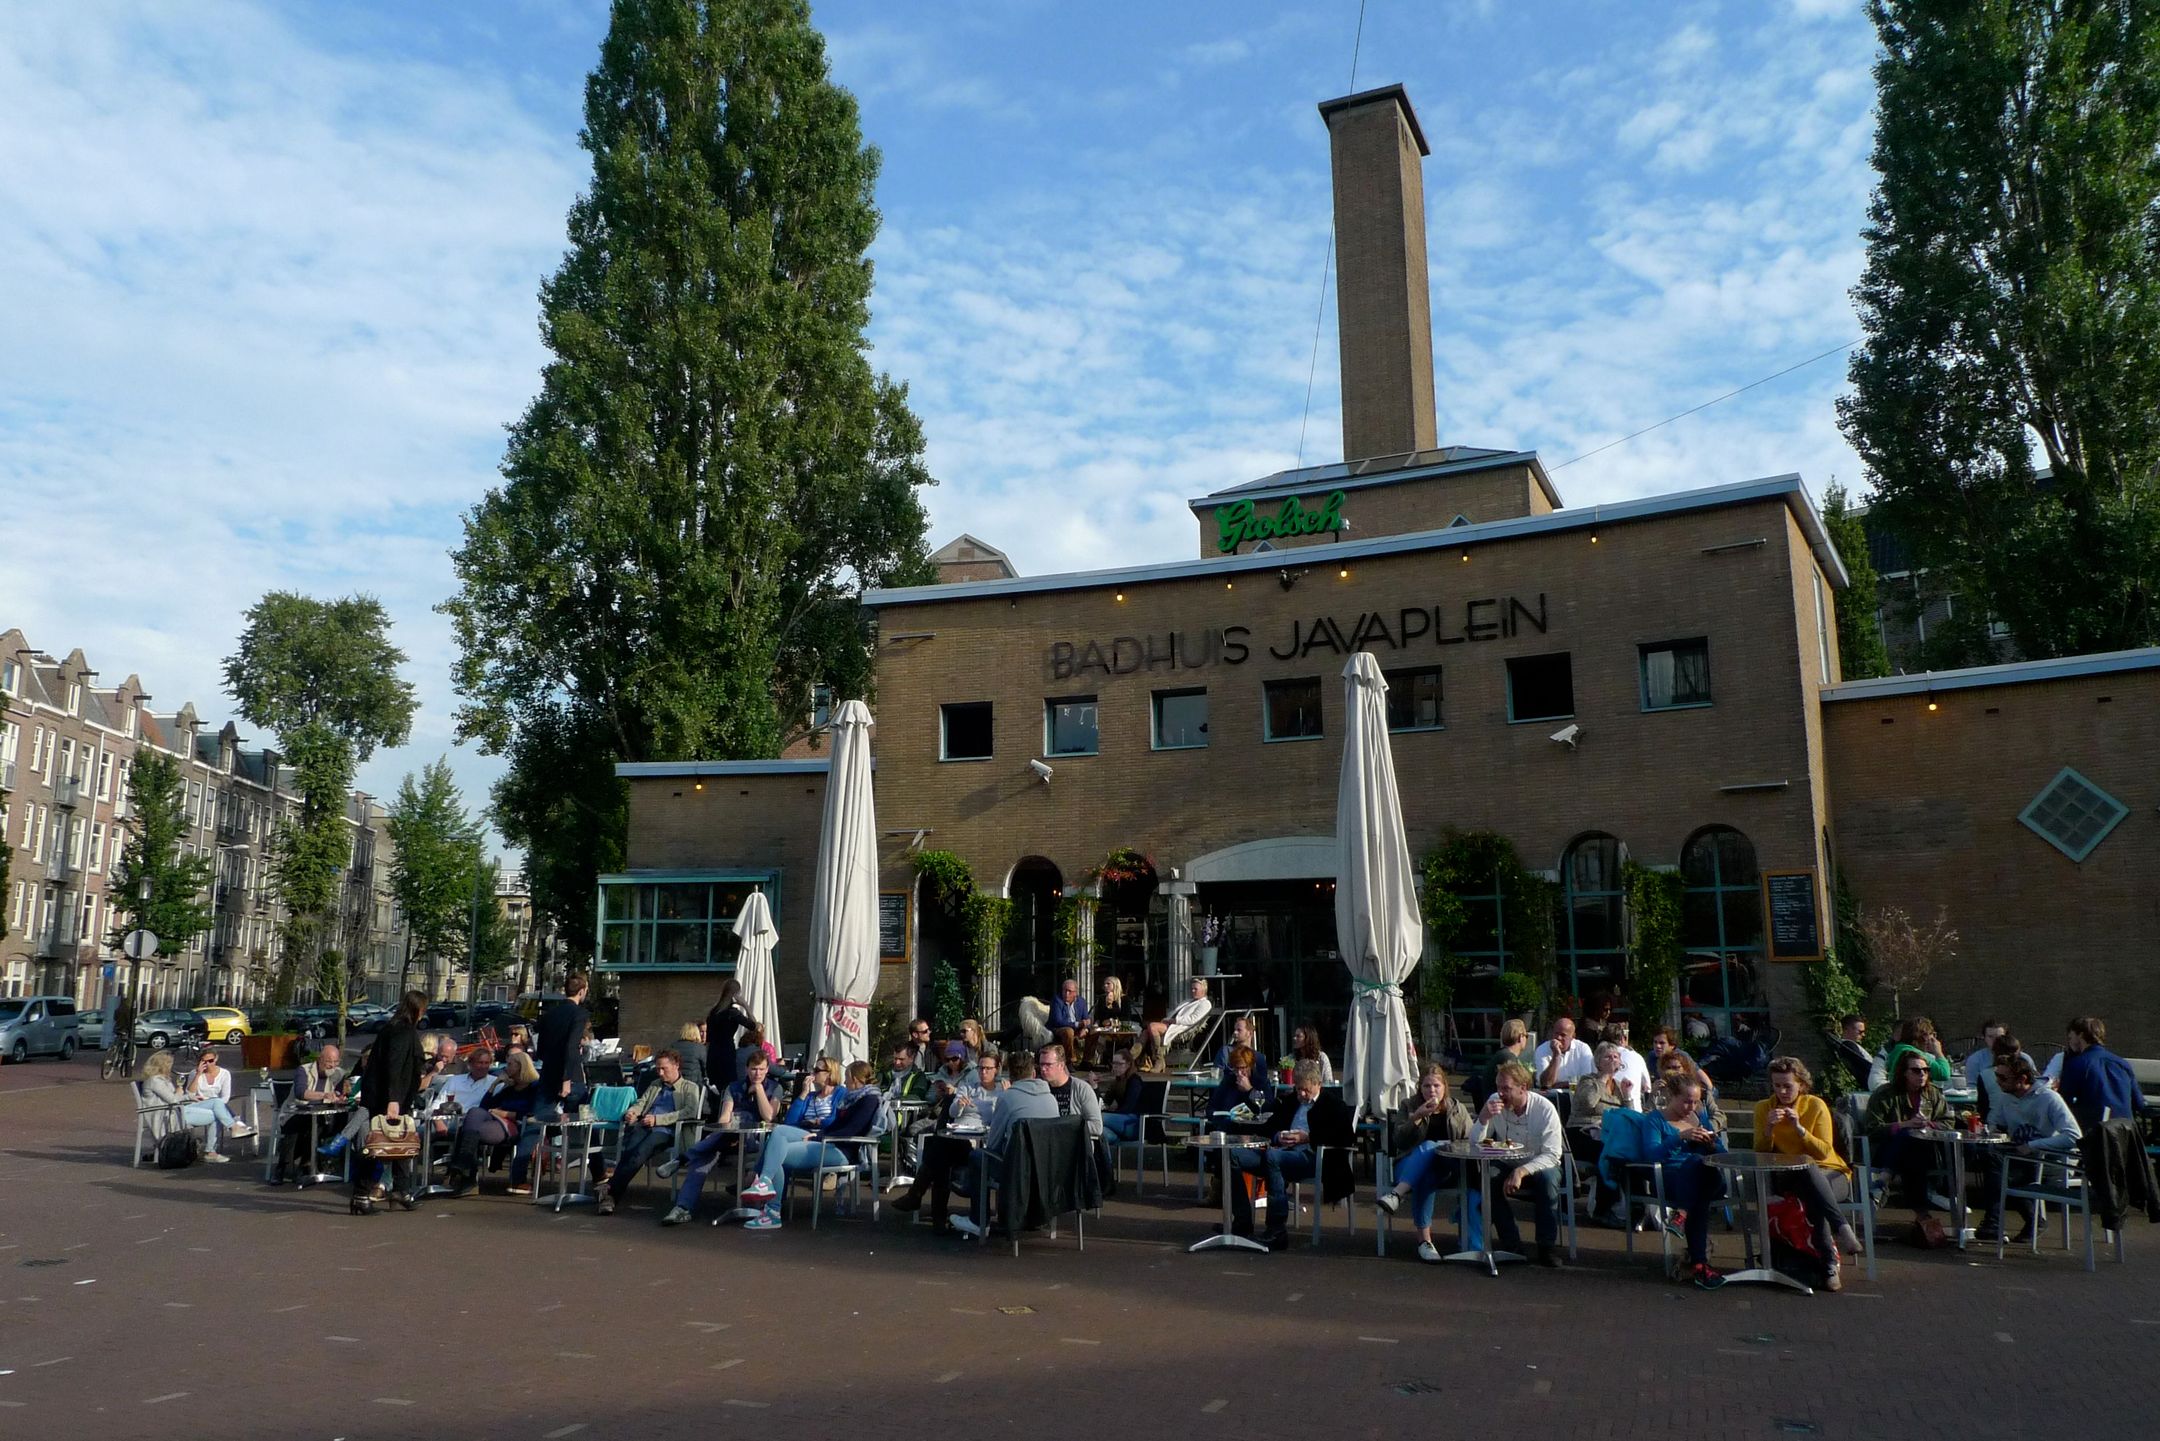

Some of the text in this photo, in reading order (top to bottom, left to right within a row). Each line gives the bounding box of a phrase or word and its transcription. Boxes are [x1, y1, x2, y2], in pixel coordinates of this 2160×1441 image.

[1215, 489, 1345, 552] Grolsch
[1053, 593, 1547, 679] BADHUIS JAVAPLEIN
